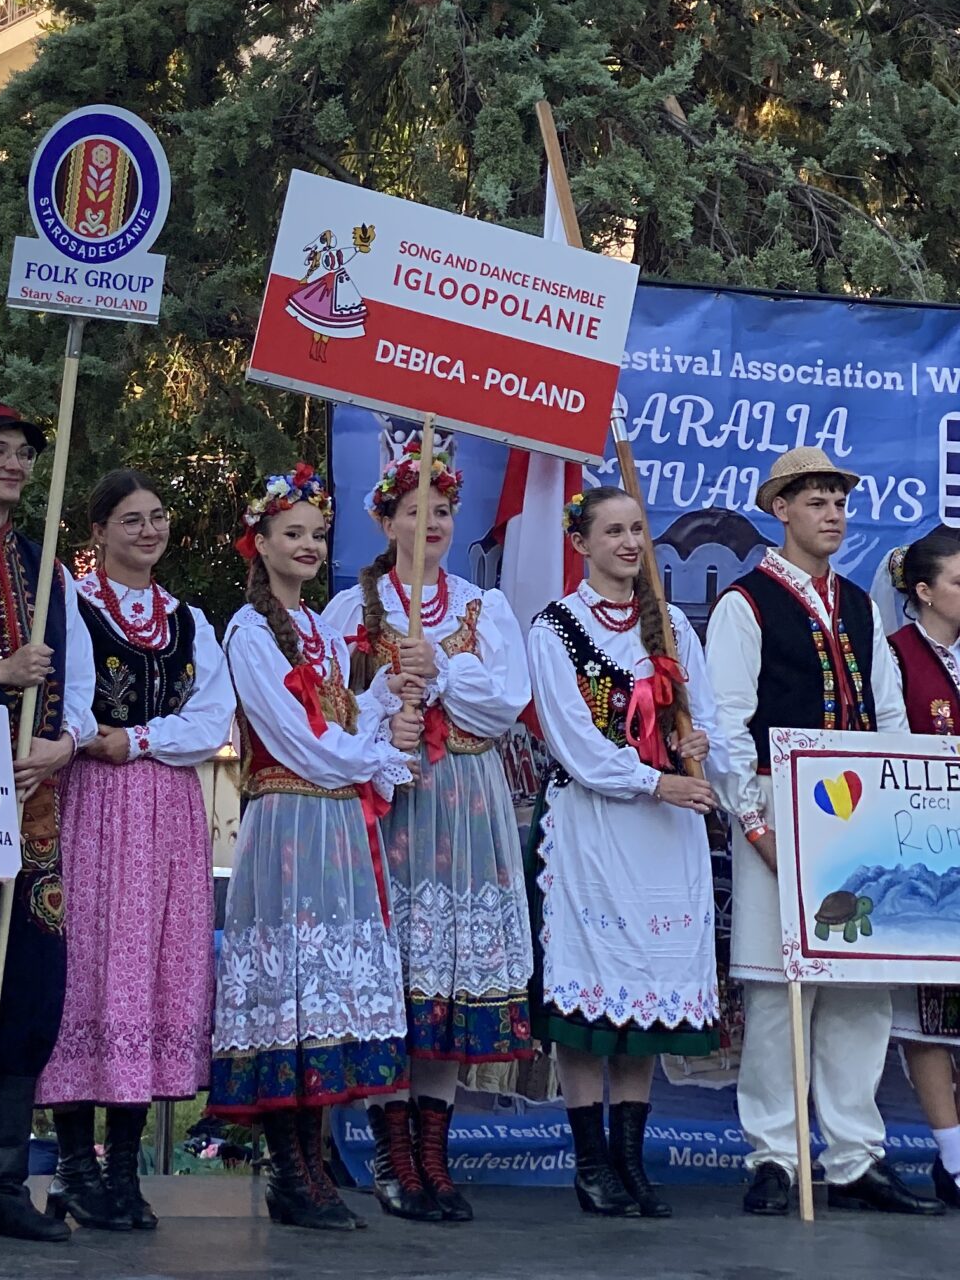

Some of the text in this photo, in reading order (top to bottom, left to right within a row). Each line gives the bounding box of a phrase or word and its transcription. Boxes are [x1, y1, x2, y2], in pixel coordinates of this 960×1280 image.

[40, 197, 151, 259] STAROSĄDECZANIE
[20, 286, 53, 302] Stary
[95, 295, 148, 312] POLAND
[24, 261, 155, 294] FOLK GROUP
[393, 264, 602, 340] IGLOOPOLANIE
[398, 240, 607, 309] SONG AND DANCE ENSEMBLE
[375, 339, 467, 384] DEBICA
[484, 368, 586, 413] POLAND
[620, 346, 722, 376] estival
[729, 351, 904, 391] Association
